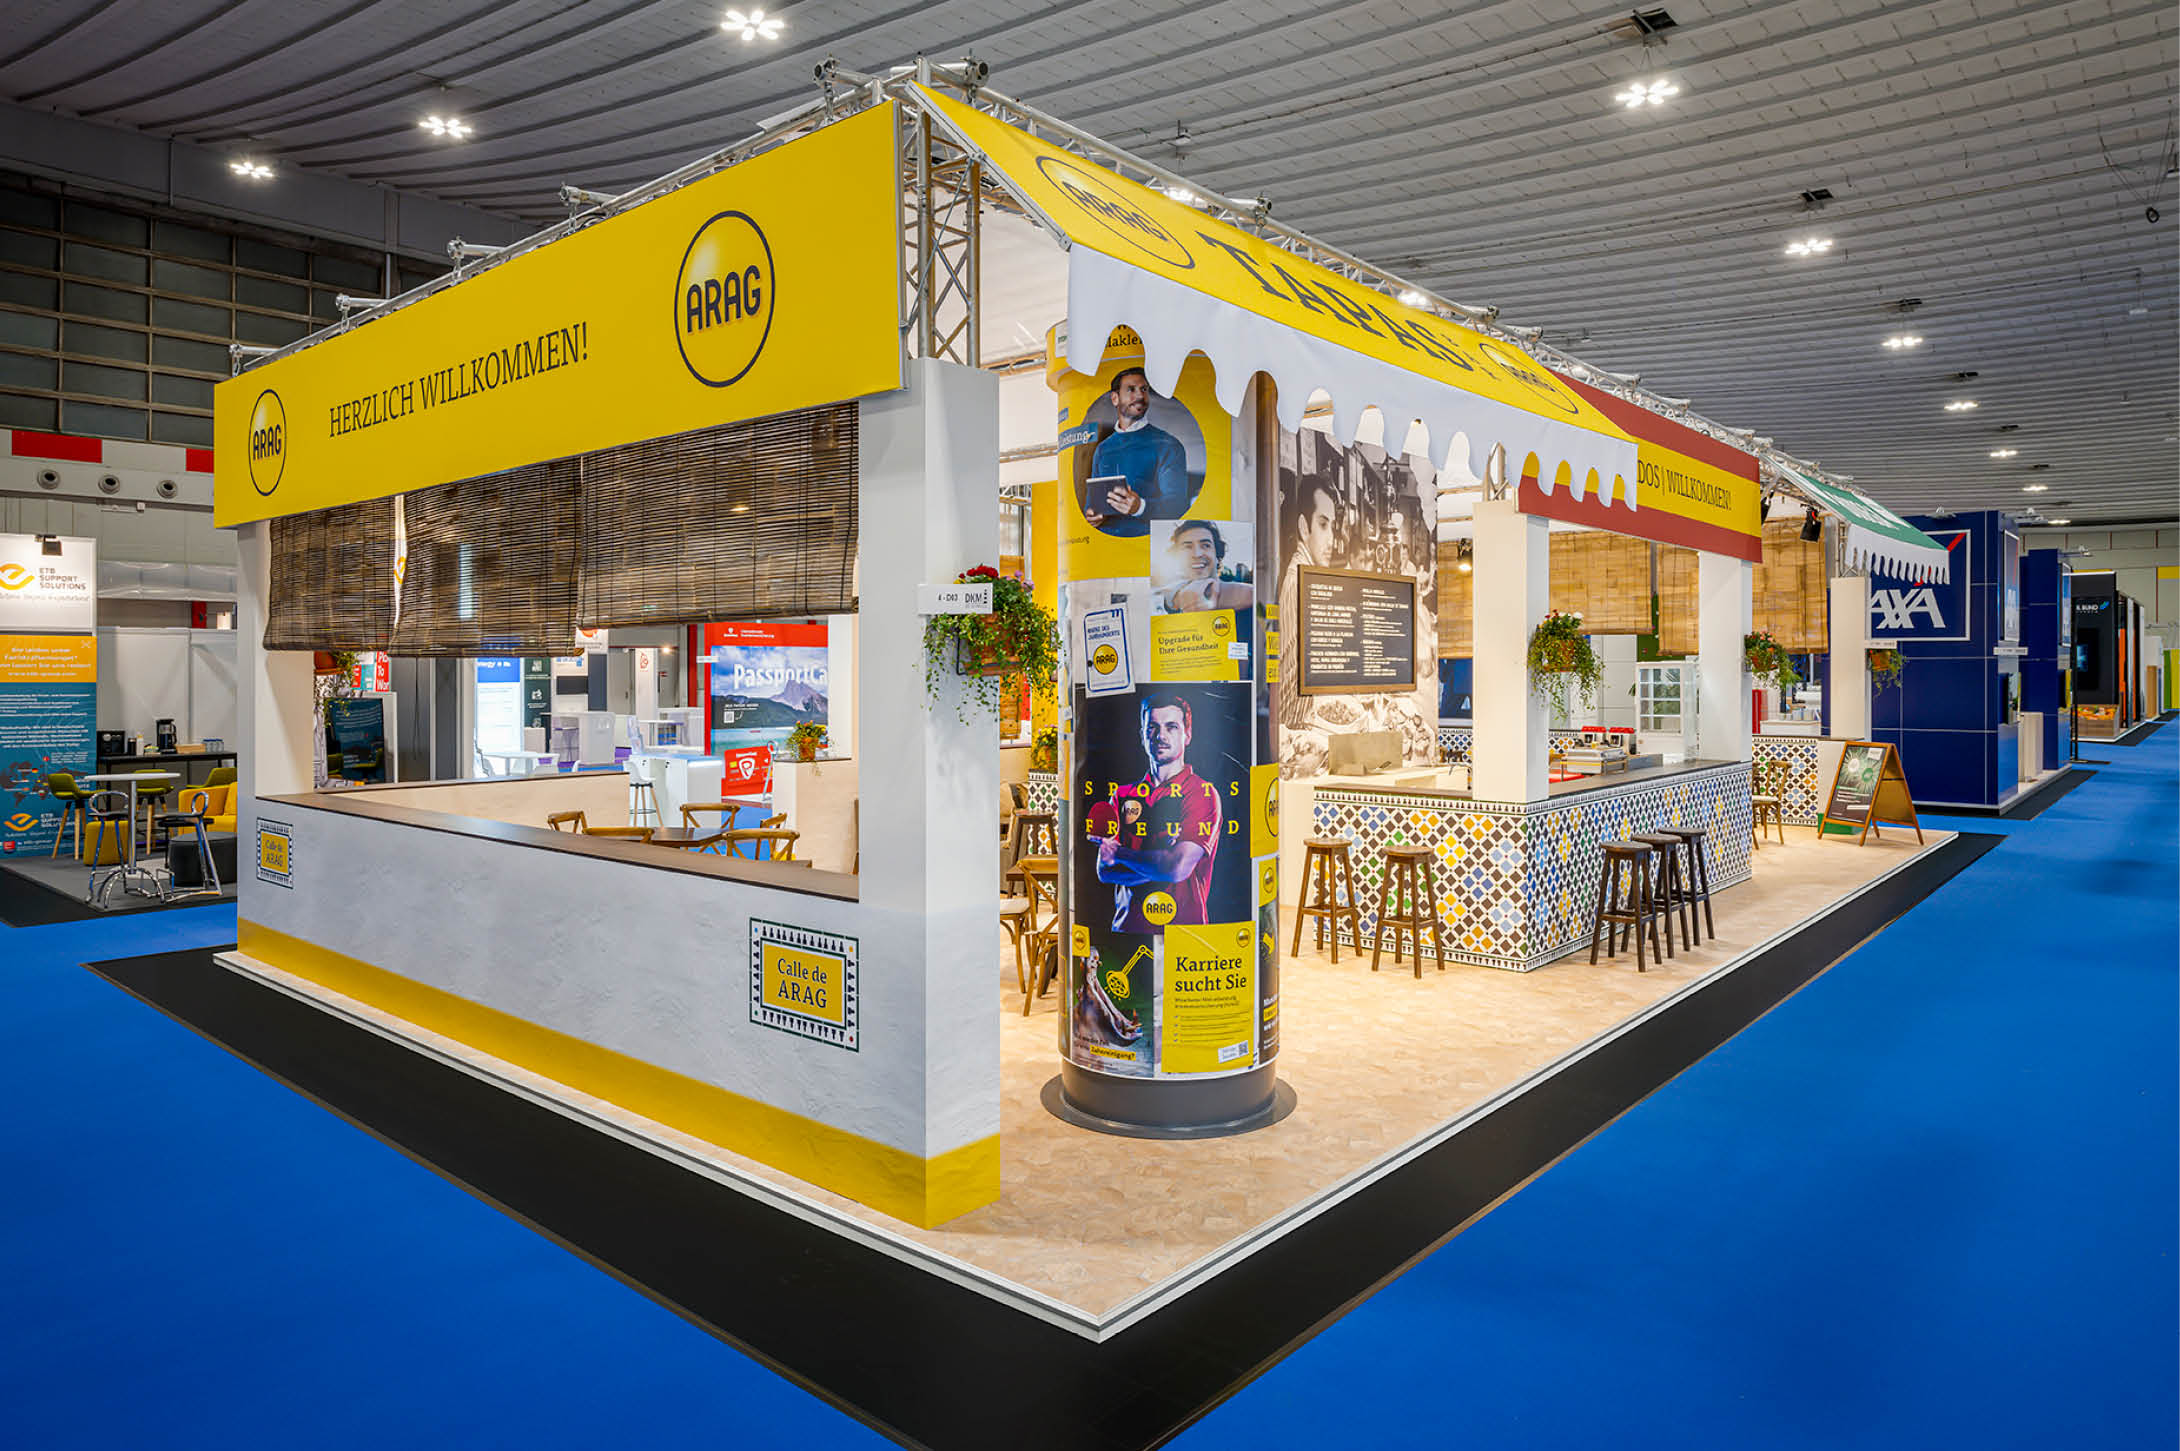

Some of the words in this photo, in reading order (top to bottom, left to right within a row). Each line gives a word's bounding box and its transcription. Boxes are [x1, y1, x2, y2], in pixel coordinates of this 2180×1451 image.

[1061, 181, 1168, 243] ARAG
[685, 264, 763, 334] ARAG
[1194, 230, 1474, 372] TAPAS
[329, 381, 414, 438] HERZLICH
[419, 322, 589, 411] WILLKOMMEN!
[252, 422, 283, 462] ARAG
[1666, 469, 1732, 511] WILLKOMMEN!
[964, 592, 982, 603] DKM
[1871, 588, 1946, 629] AXA
[1157, 635, 1191, 646] Upgrade
[1191, 633, 1204, 642] für
[1158, 647, 1175, 655] Ihre
[1176, 643, 1219, 653] Gesundheit
[1096, 653, 1116, 665] ARAG
[265, 853, 283, 867] ARAG
[1145, 902, 1174, 914] ARAG
[777, 958, 809, 980] Calle
[811, 965, 827, 984] de
[1175, 956, 1242, 973] Karriere
[778, 979, 828, 1008] ARAG
[1174, 976, 1220, 993] sucht
[1225, 973, 1247, 989] Sie
